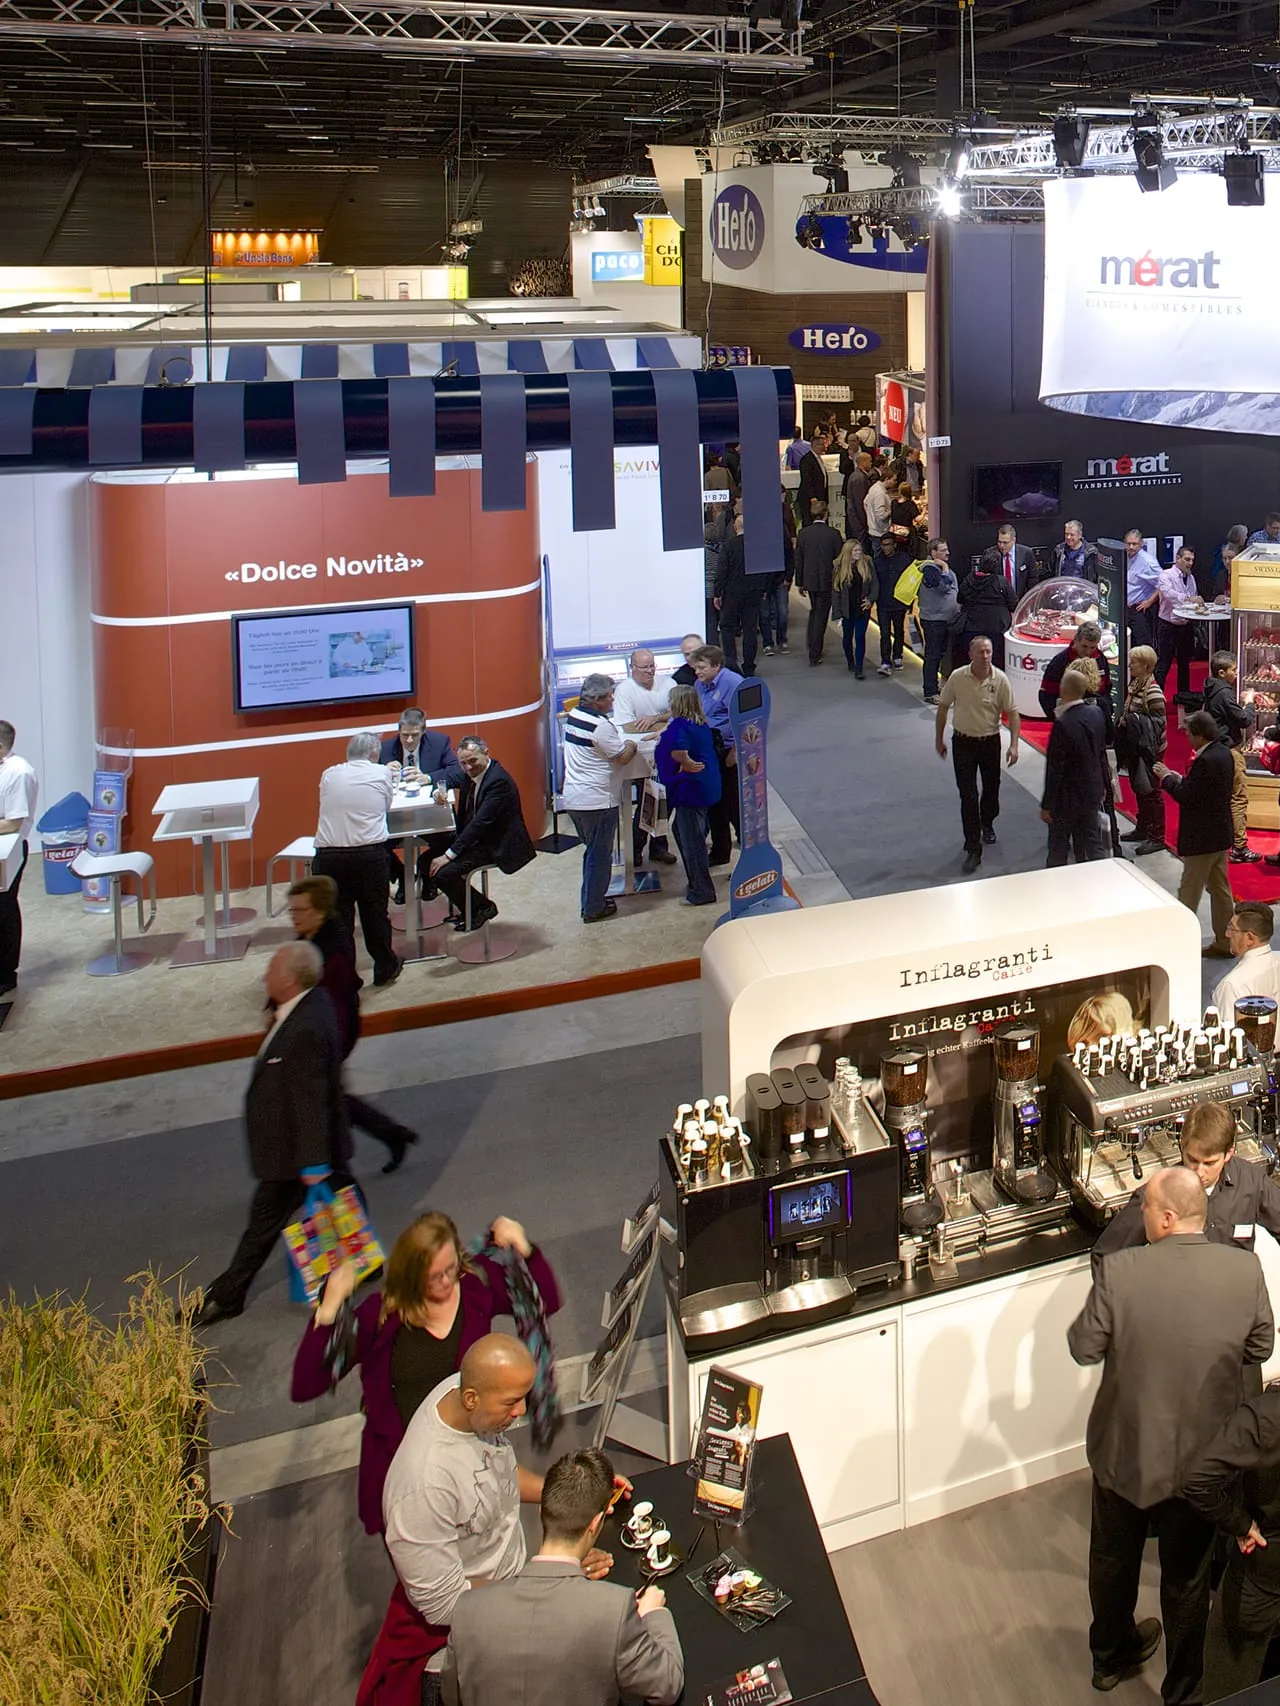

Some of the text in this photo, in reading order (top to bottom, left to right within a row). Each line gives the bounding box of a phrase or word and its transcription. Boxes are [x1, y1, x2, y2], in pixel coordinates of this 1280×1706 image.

[717, 193, 757, 252] Hero
[595, 254, 645, 273] paco
[1100, 249, 1221, 289] mérat
[803, 326, 868, 350] Hero
[889, 405, 902, 424] NEU
[1087, 452, 1169, 476] mérat
[1074, 482, 1113, 490] VIANDES
[1123, 477, 1182, 487] COMESTIBLES
[225, 552, 424, 583] «Dolce Novità»
[744, 872, 776, 895] gelati
[900, 943, 1053, 988] Inflagranti
[888, 997, 1036, 1042] Inflagranti
[936, 1043, 961, 1055] echter
